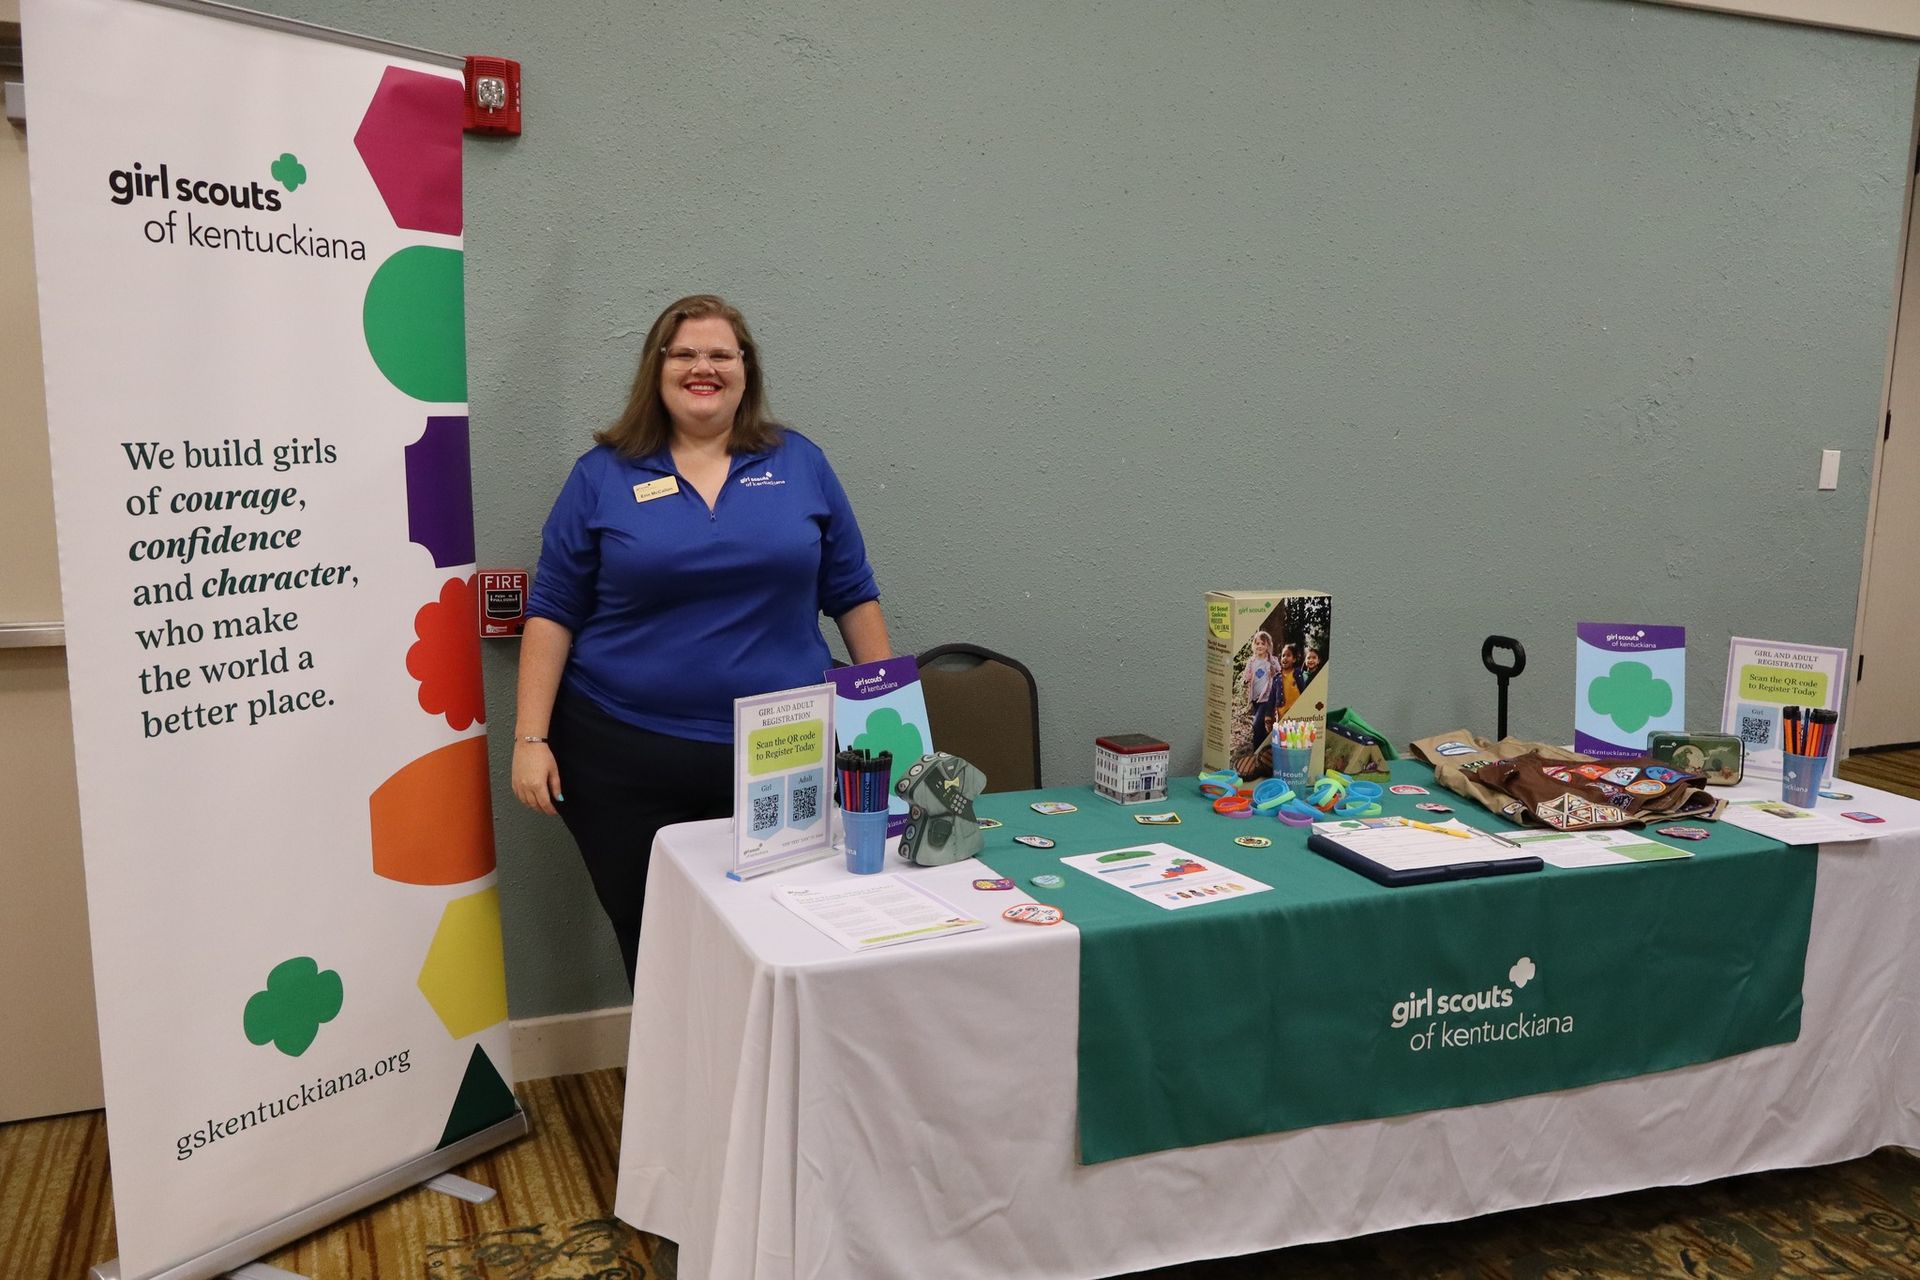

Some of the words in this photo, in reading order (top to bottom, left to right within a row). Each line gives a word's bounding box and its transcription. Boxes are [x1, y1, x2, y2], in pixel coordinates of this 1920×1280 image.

[109, 162, 169, 205] girl
[176, 177, 282, 212] scouts
[144, 210, 177, 243] of
[188, 212, 366, 260] kentuckiana
[121, 441, 175, 470] We
[183, 438, 263, 468] build
[273, 437, 337, 472] girls
[126, 486, 162, 516] of
[170, 486, 306, 515] courage,
[128, 525, 302, 564] confidence
[133, 573, 194, 606] and
[201, 562, 359, 598] character,
[485, 576, 522, 588] FIRE
[135, 618, 204, 650] who
[212, 607, 299, 640] make
[1606, 634, 1618, 642] girl
[1754, 650, 1772, 658] GIRL
[1792, 654, 1818, 662] ADULT
[1758, 659, 1814, 670] REGISTRATION
[138, 665, 191, 695] the
[200, 646, 289, 683] world
[298, 649, 314, 670] a
[855, 678, 864, 688] girl
[864, 676, 882, 684] scouts
[860, 686, 866, 694] of
[868, 682, 898, 692] kentuckiana
[1750, 674, 1768, 682] Scan
[1770, 676, 1782, 684] the
[1784, 678, 1797, 686] QR
[1758, 684, 1790, 694] Register
[1792, 687, 1817, 698] Today
[141, 702, 238, 738] better
[248, 688, 335, 726] place.
[758, 707, 775, 717] GIRL
[776, 704, 790, 714] AND
[792, 700, 814, 710] ADULT
[762, 711, 811, 726] REGISTRATION
[756, 740, 774, 750] Scan
[774, 737, 786, 746] the
[787, 734, 798, 744] QR
[800, 730, 816, 740] code
[766, 748, 794, 759] Register
[795, 742, 816, 752] Today
[1584, 749, 1642, 758] GSKentuckiana.org
[761, 784, 772, 792] Girl
[1391, 987, 1433, 1028] girl
[1437, 985, 1513, 1015] scouts
[1410, 1022, 1437, 1051] of
[1441, 1012, 1573, 1048] kentuckiana
[176, 1049, 411, 1161] gskentuckiana.org
